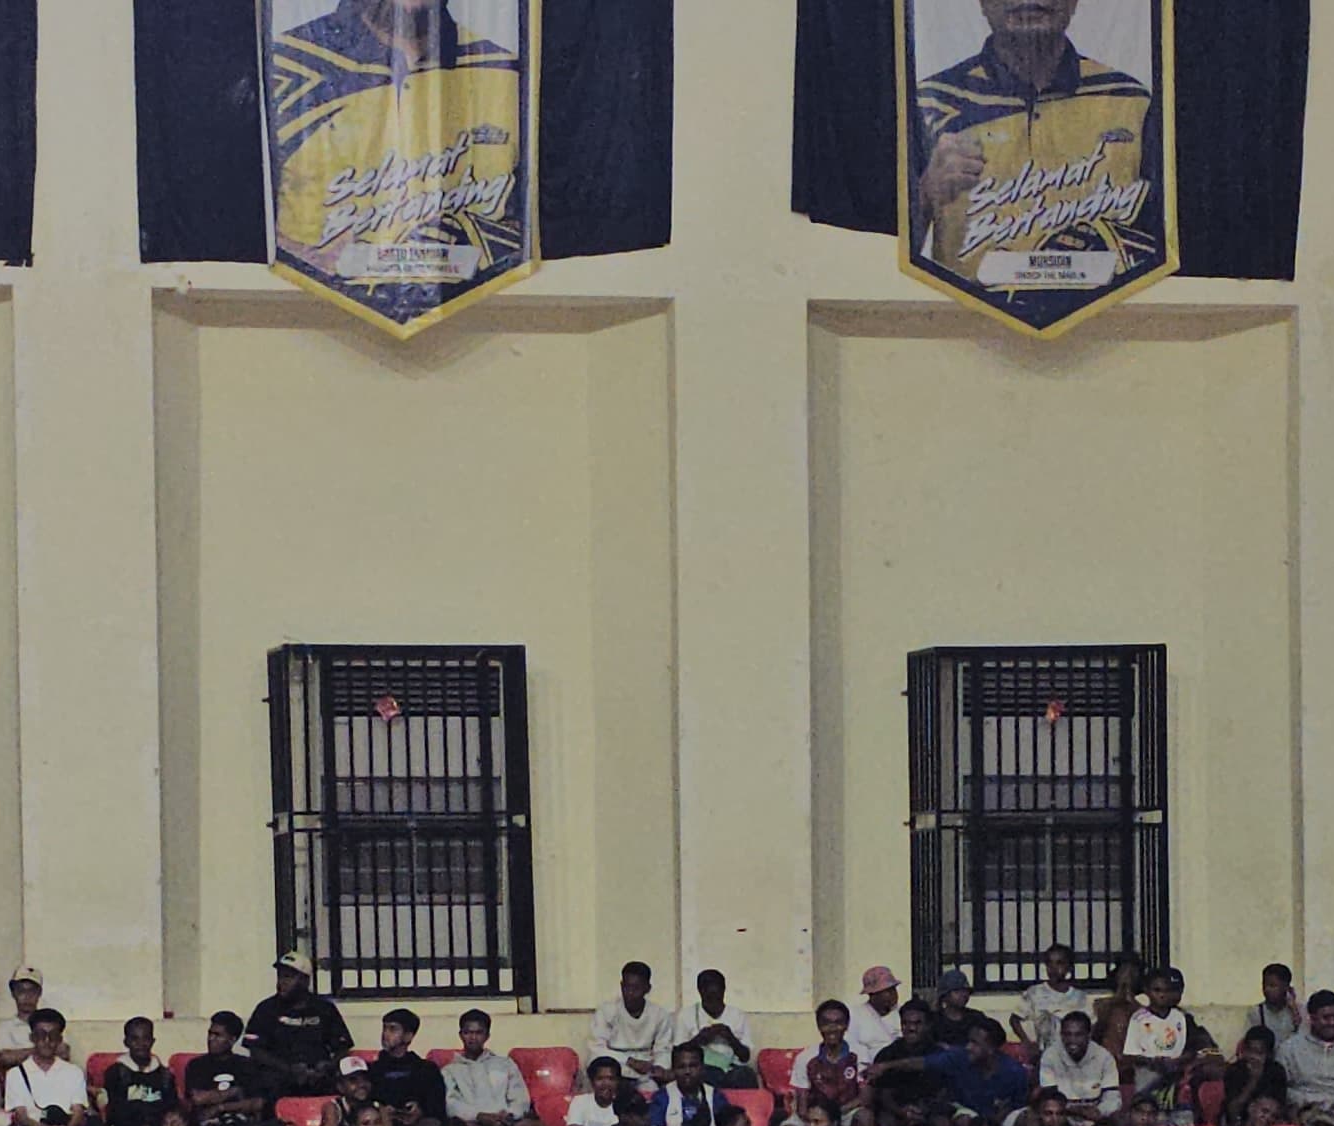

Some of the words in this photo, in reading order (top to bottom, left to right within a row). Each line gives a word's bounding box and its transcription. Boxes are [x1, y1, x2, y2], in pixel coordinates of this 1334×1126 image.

[317, 166, 516, 249] Bertanding
[323, 131, 470, 206] Selamat
[965, 140, 1107, 216] Selamat
[957, 173, 1150, 261] Bertanding
